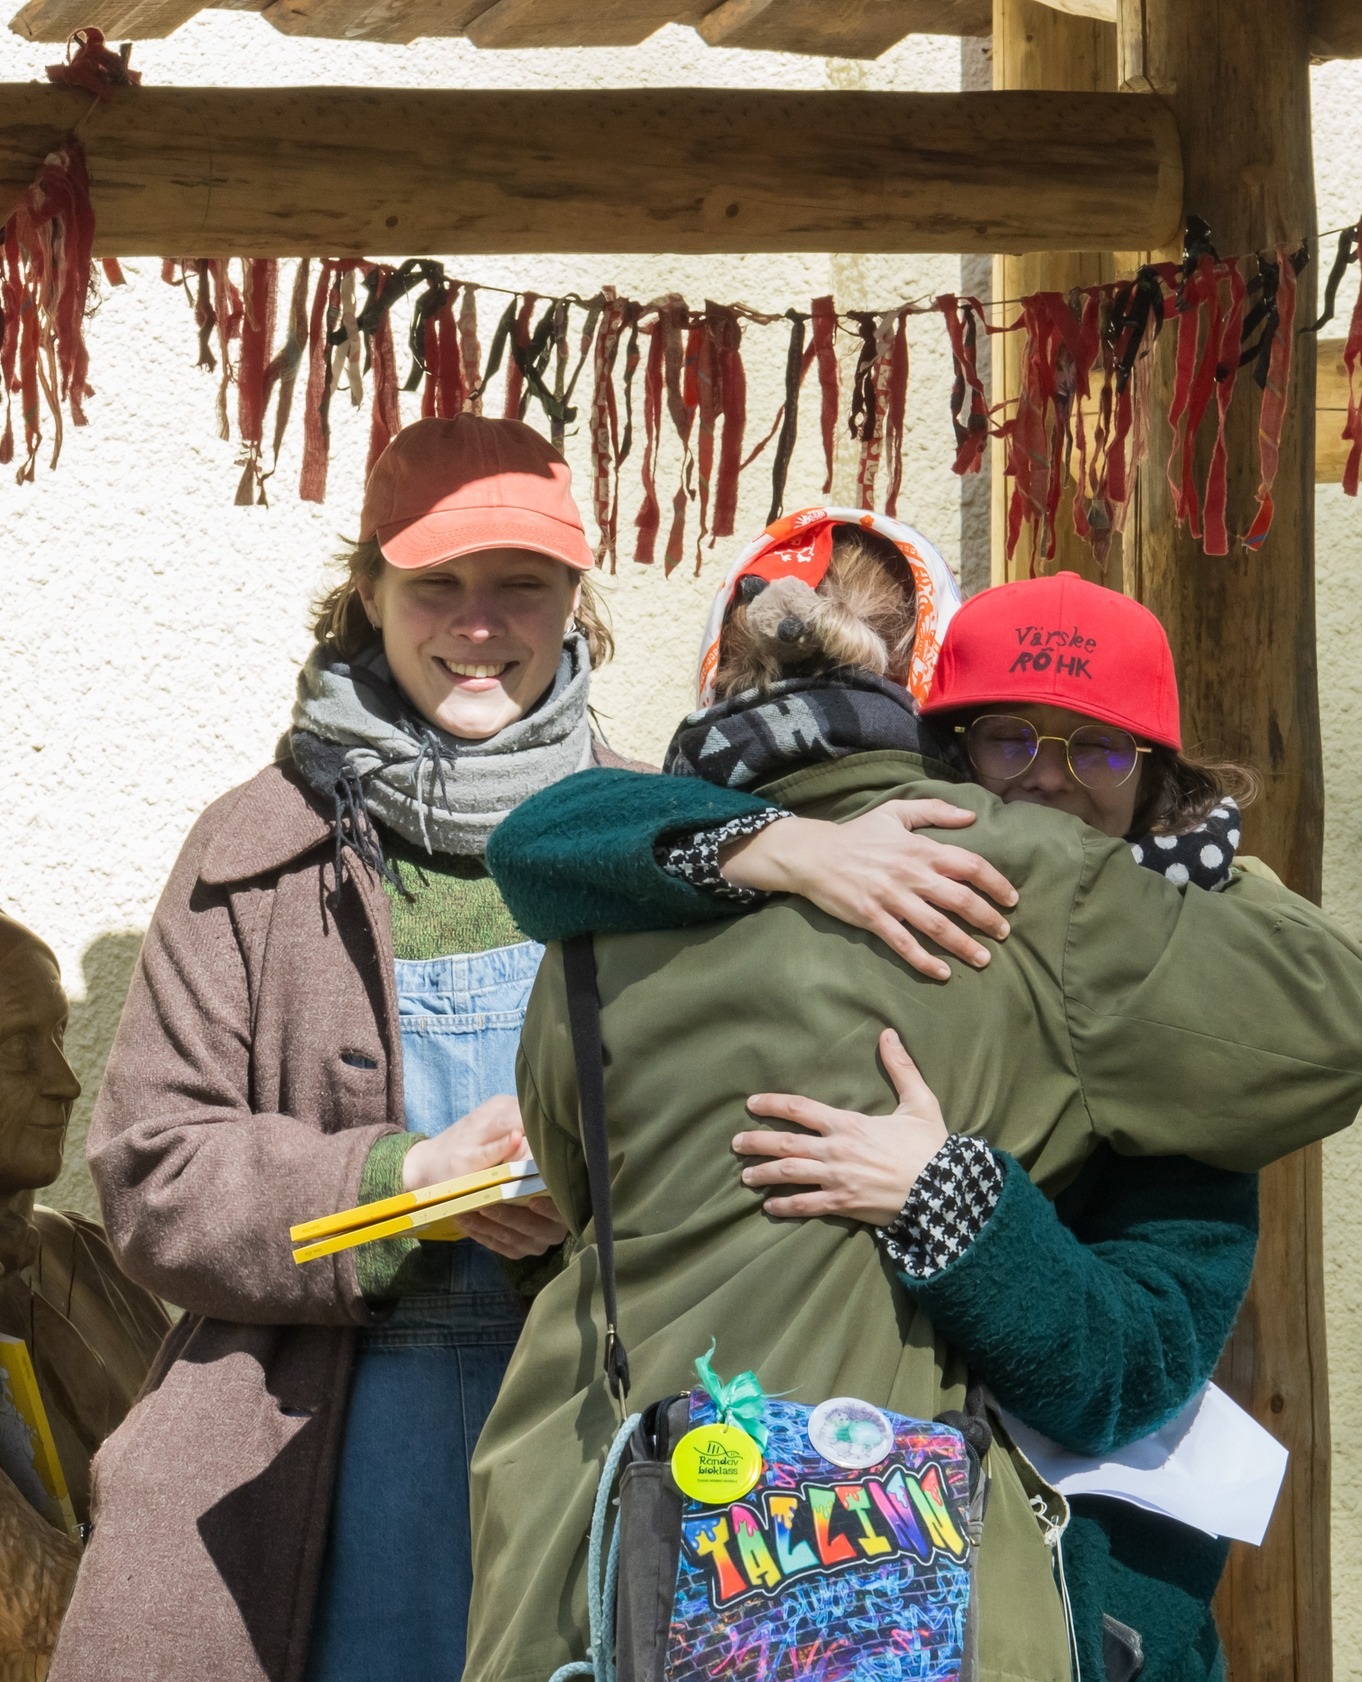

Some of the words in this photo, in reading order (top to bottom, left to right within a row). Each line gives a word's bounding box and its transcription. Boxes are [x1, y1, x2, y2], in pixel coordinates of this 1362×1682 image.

[1015, 626, 1097, 654] Värske
[1008, 647, 1092, 680] RÕHK
[683, 1466, 965, 1601] TALLINN
